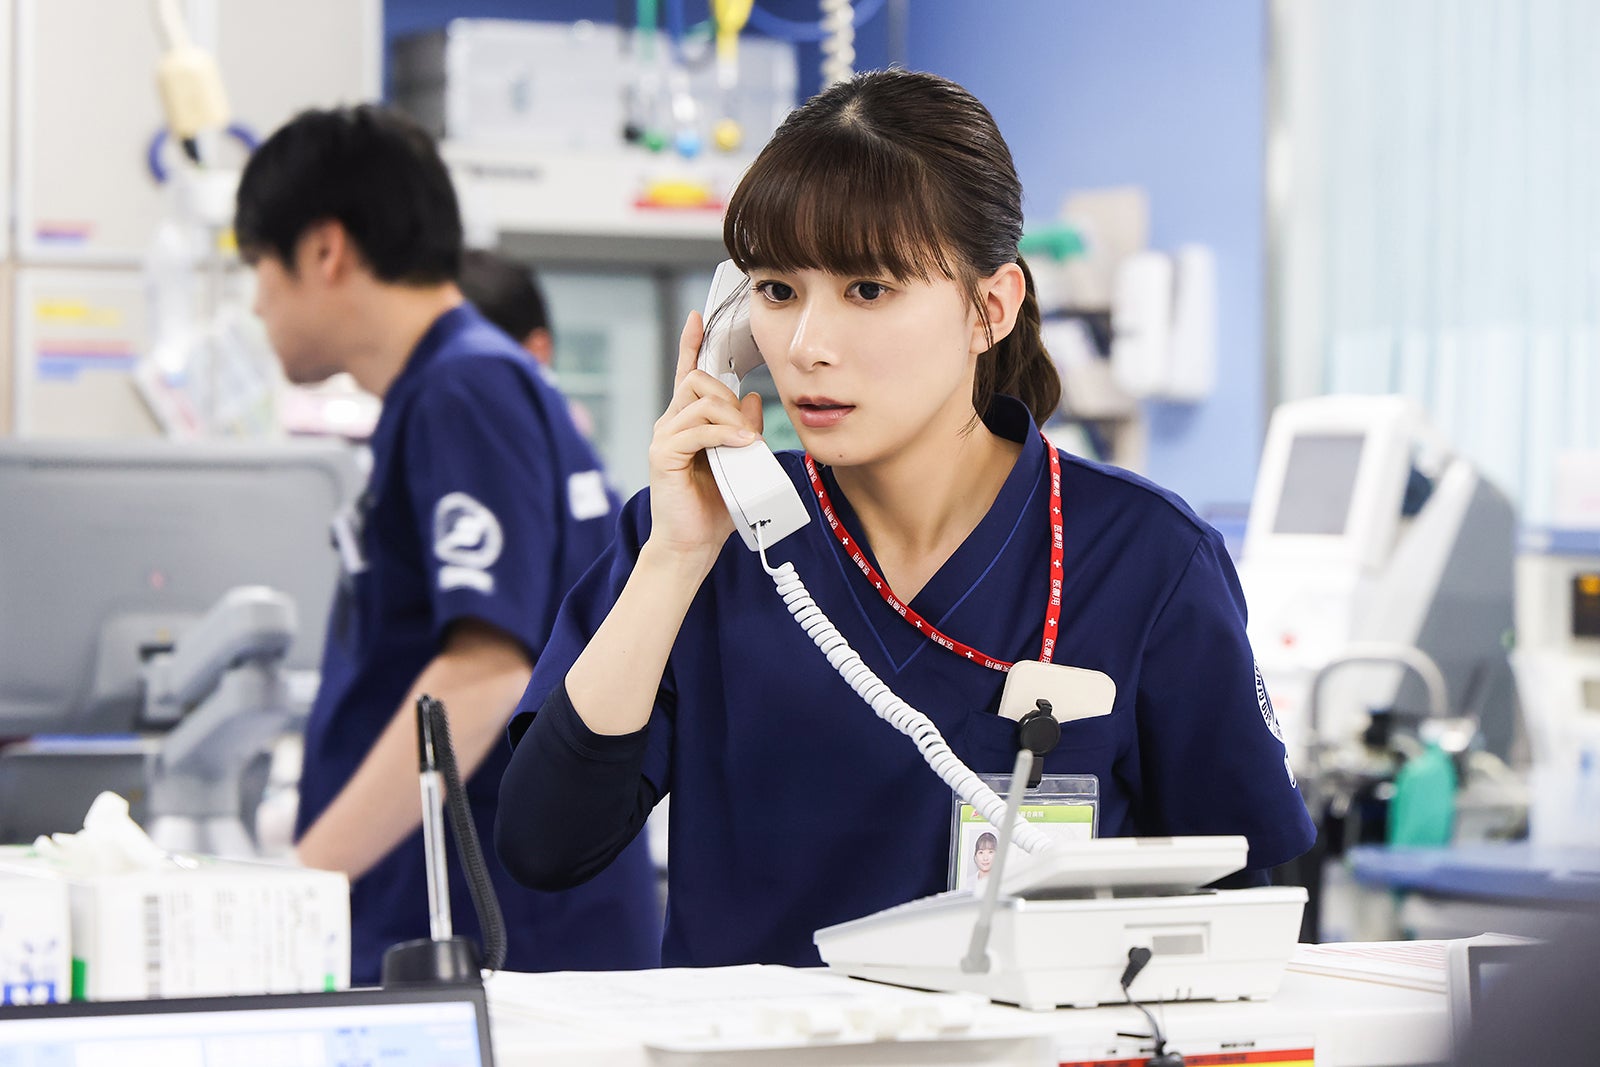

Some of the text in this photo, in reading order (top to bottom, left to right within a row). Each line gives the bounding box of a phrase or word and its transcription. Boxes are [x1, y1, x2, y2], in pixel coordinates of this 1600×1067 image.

[1053, 524, 1063, 550] 医療用
[852, 552, 871, 576] 医療用
[1050, 579, 1061, 606] 医療用
[886, 594, 907, 618] 医療用
[930, 631, 954, 651] 医療用
